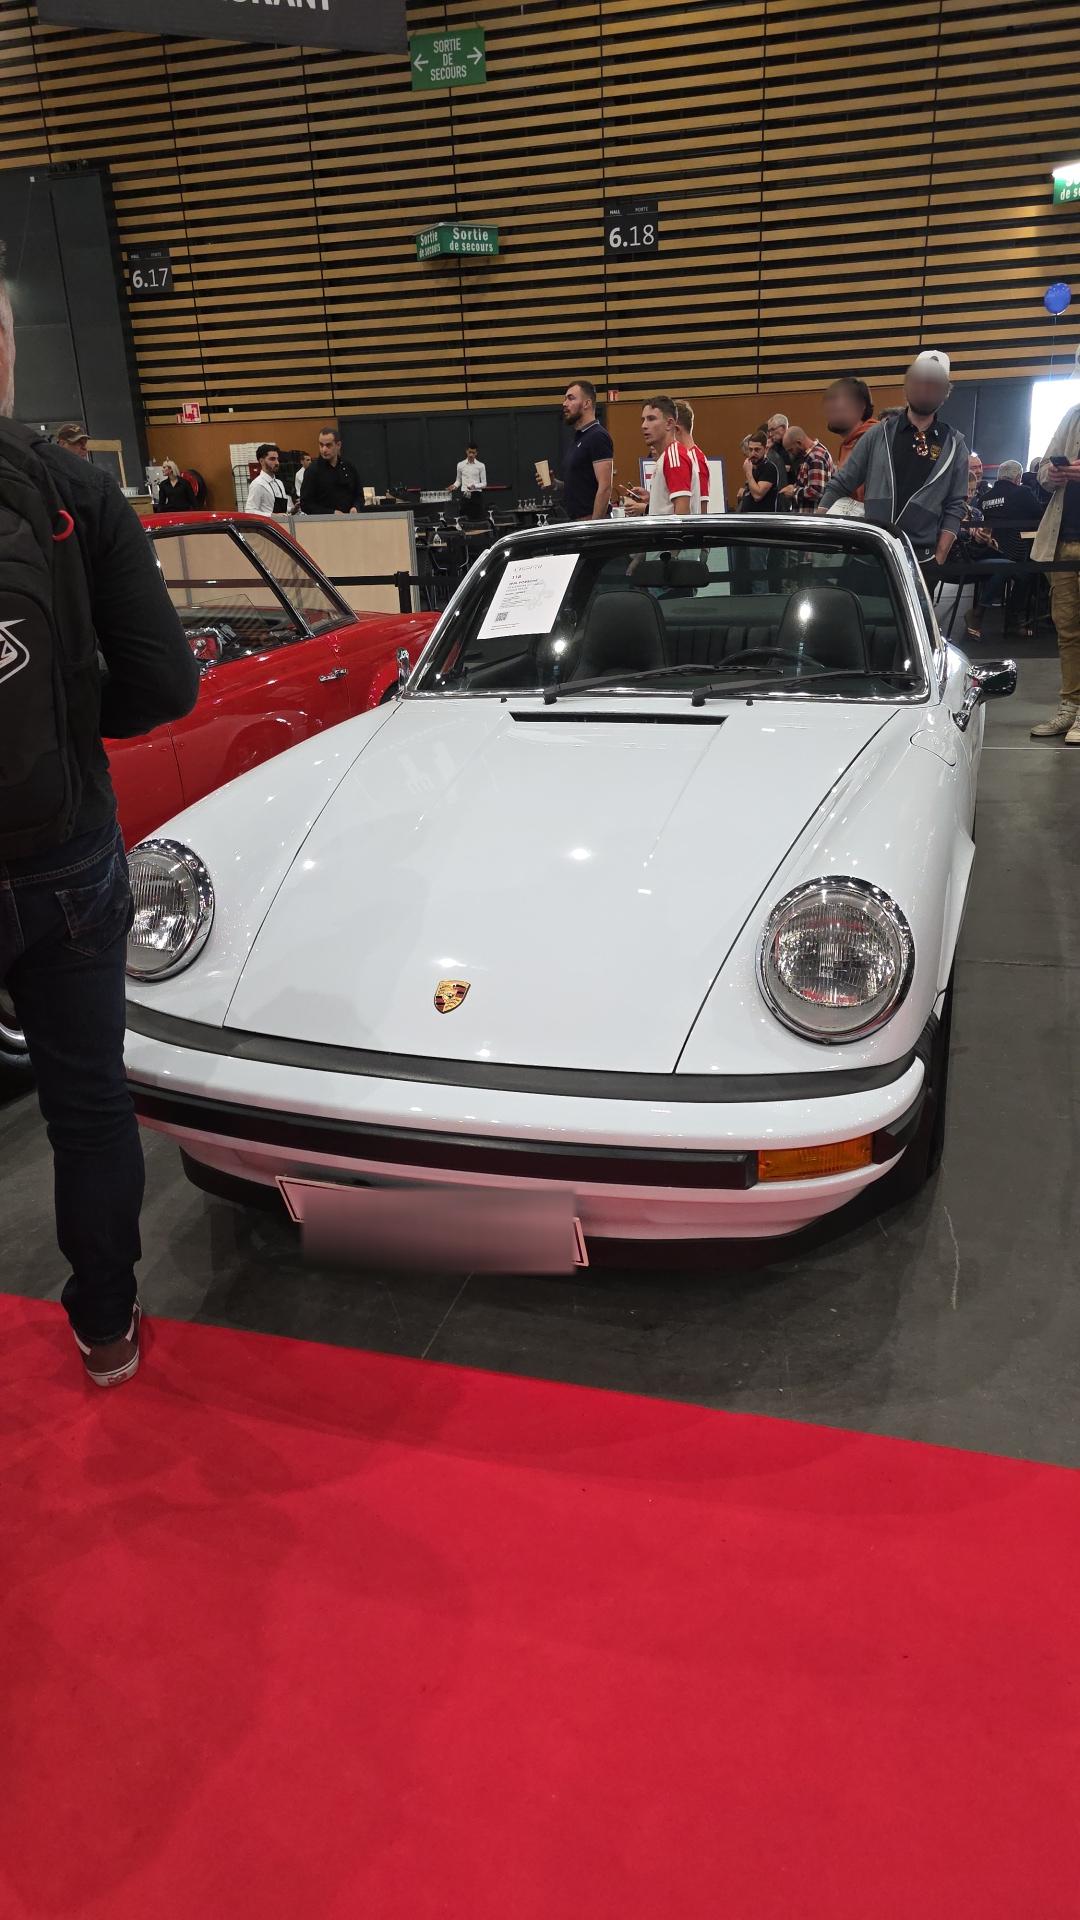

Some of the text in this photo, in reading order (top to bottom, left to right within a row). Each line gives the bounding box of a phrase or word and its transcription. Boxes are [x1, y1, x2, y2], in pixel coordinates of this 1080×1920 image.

[433, 38, 462, 53] SORTIE
[442, 53, 454, 66] DE
[430, 65, 467, 81] SECOURS
[1060, 189, 1071, 200] de
[420, 230, 439, 246] Sortie
[452, 227, 489, 241] Sortie
[609, 224, 655, 248] 6.18
[449, 240, 494, 252] de secours
[132, 267, 168, 288] 6.17
